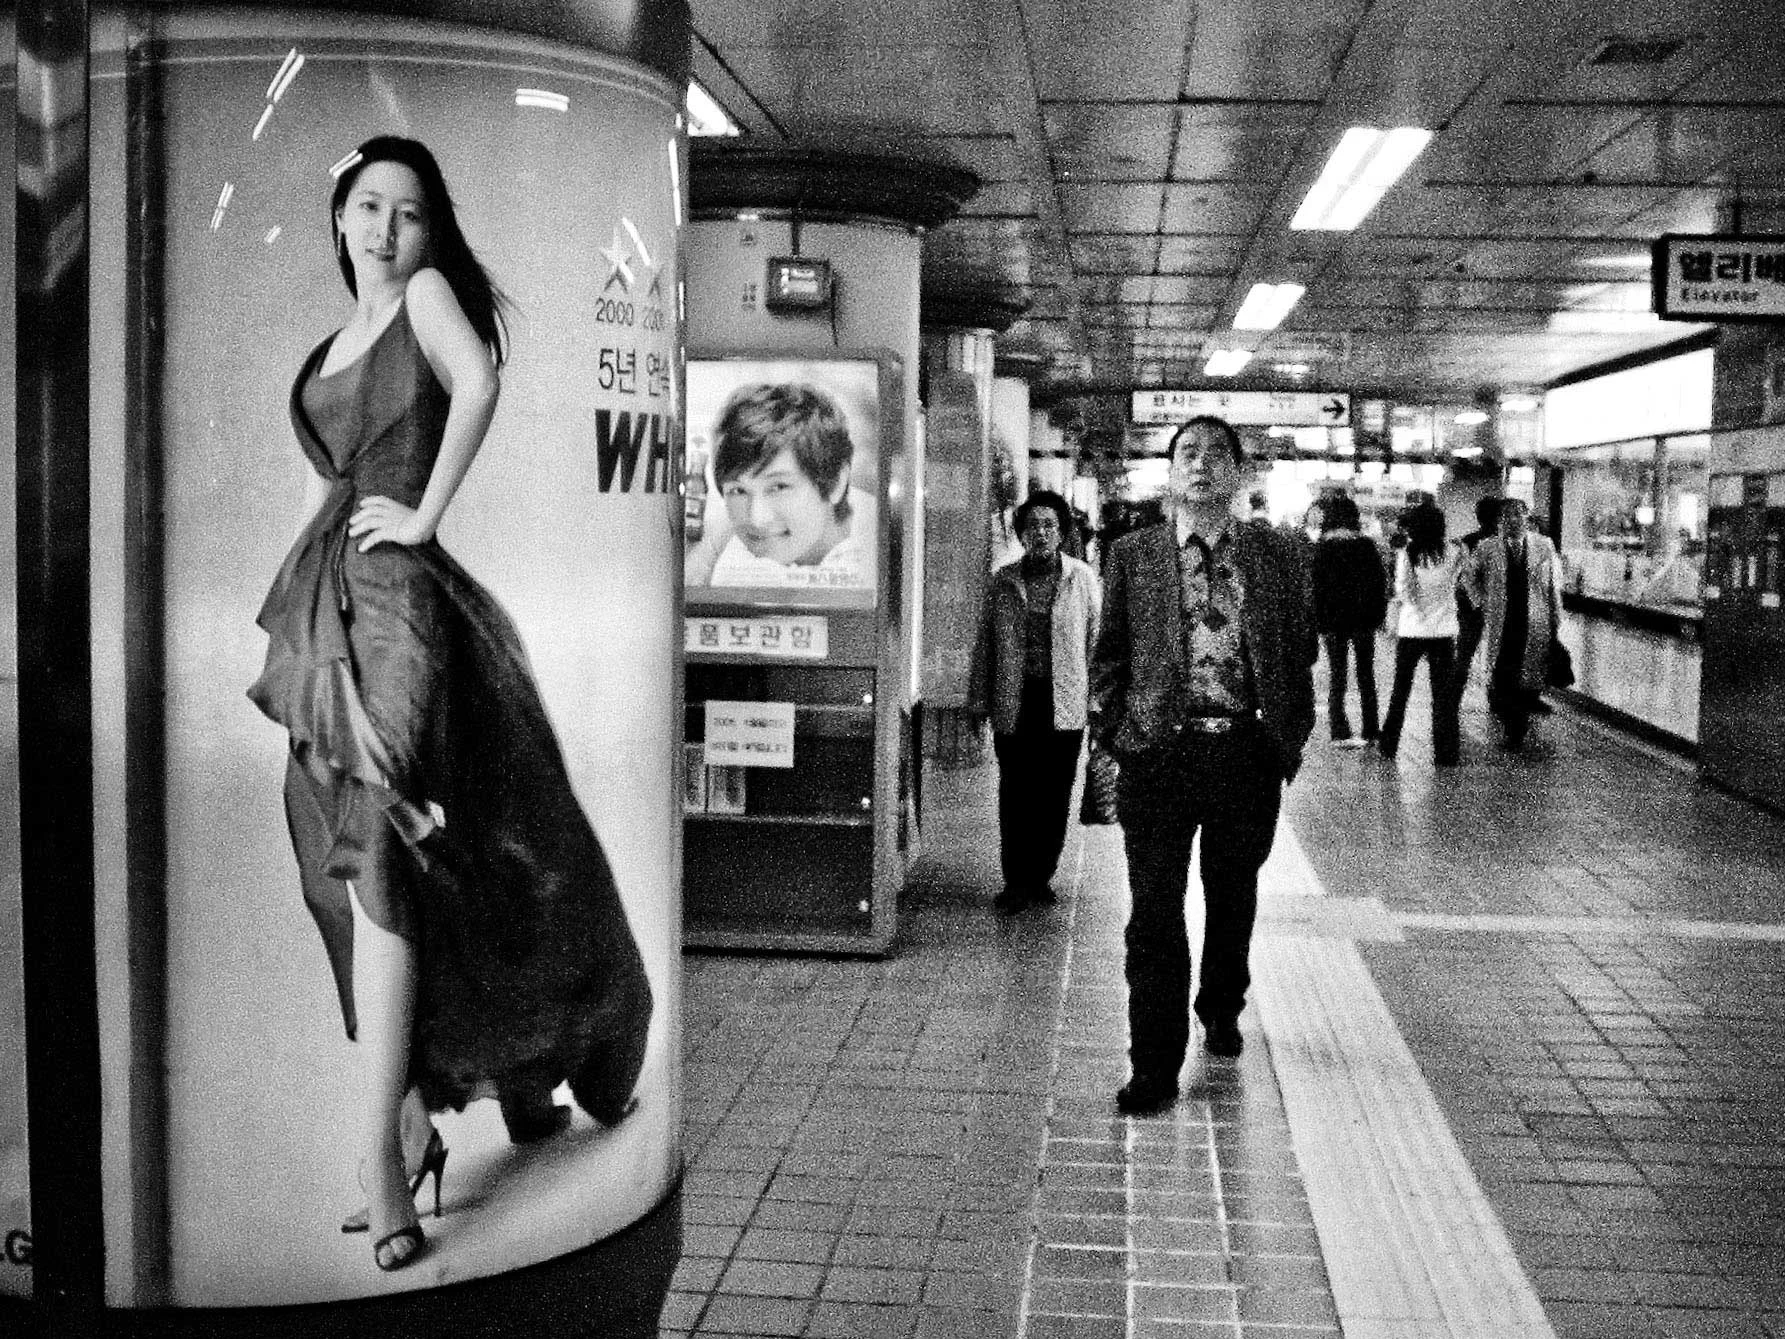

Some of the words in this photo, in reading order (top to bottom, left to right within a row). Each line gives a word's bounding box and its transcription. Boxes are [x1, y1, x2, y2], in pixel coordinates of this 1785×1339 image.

[595, 297, 634, 327] 2000
[1681, 287, 1759, 303] Elevator
[598, 346, 637, 395] 5년
[595, 409, 675, 494] WH
[684, 623, 812, 649] 품보관함
[0, 1228, 33, 1266] G
